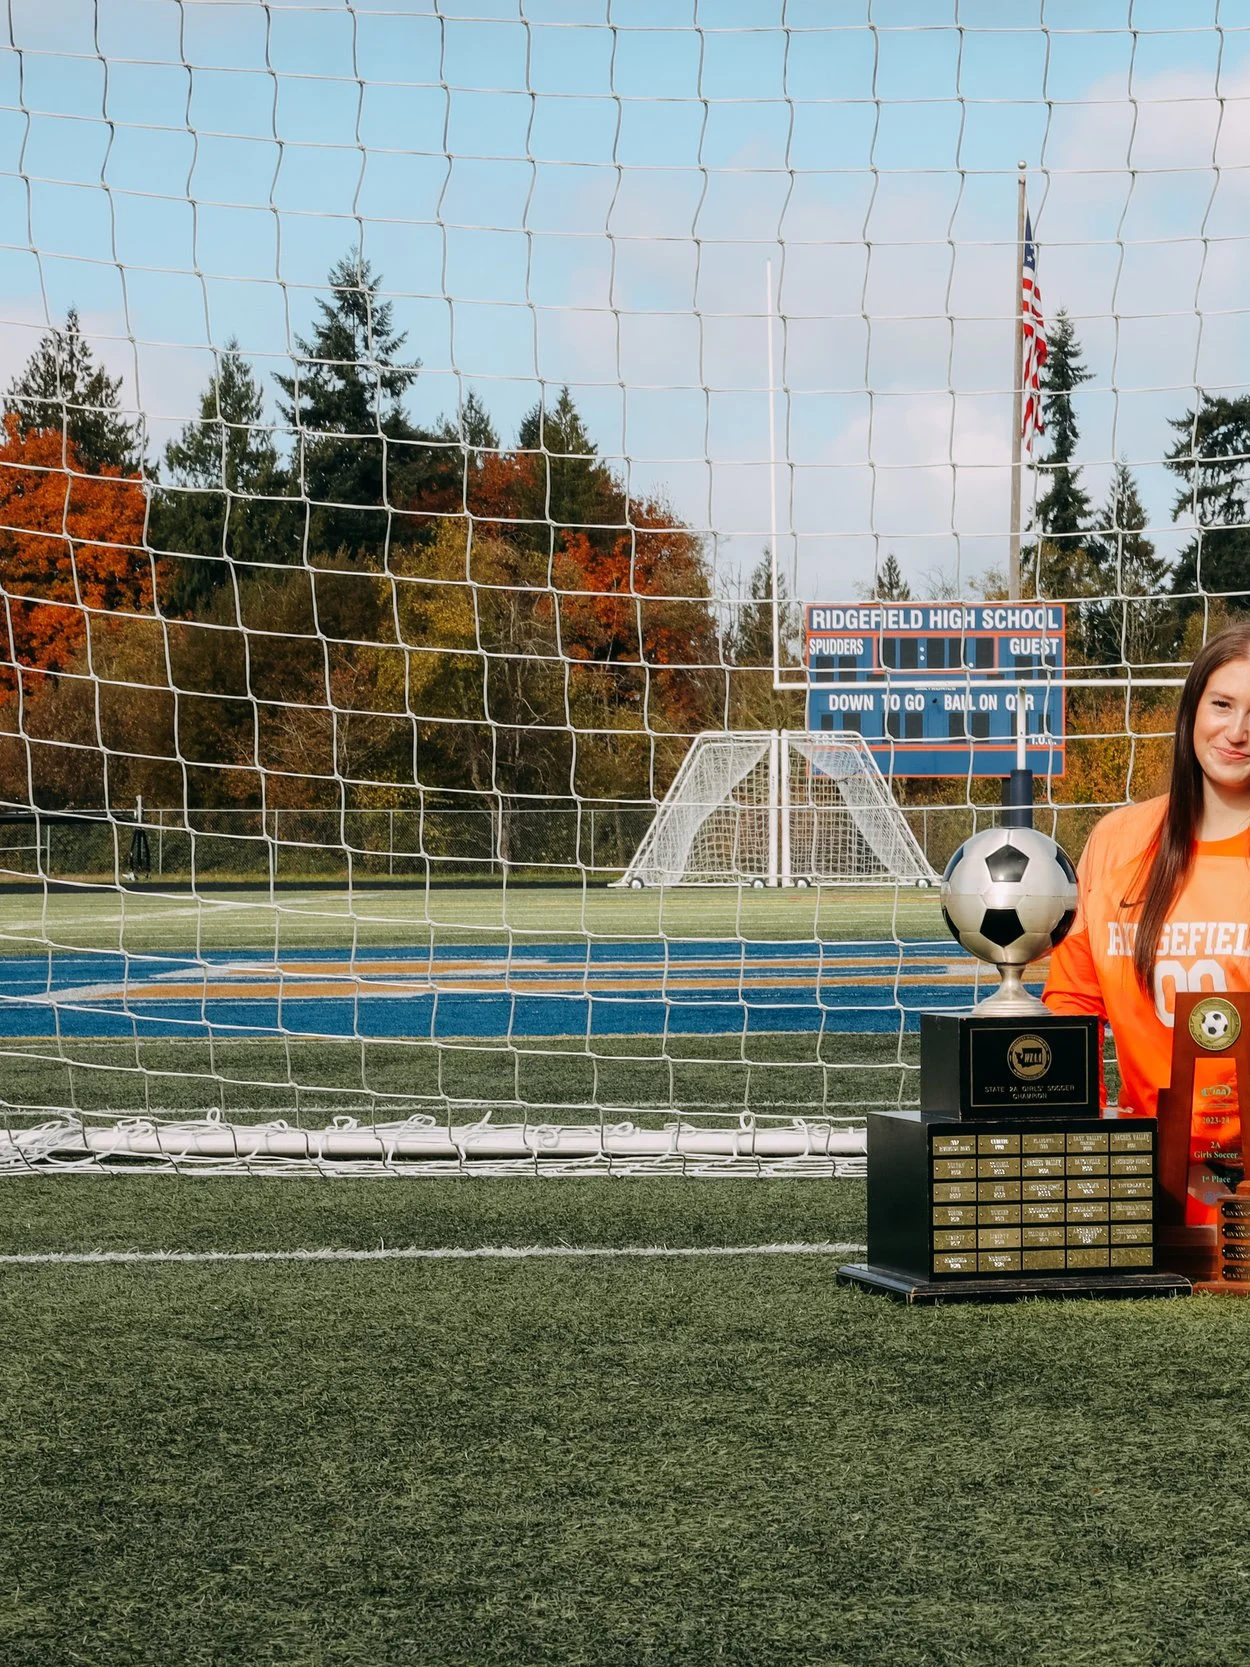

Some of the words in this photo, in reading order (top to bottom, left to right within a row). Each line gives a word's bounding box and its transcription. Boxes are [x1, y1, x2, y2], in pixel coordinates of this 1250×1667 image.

[812, 609, 923, 629] RIDGEFIELD
[929, 609, 976, 629] HIGH
[982, 609, 1059, 629] SCHOOL
[809, 638, 864, 655] SPUDDERS
[1009, 638, 1060, 655] GUEST
[828, 694, 874, 711] DOWN
[881, 694, 901, 711] TO
[904, 694, 925, 711] GO
[944, 694, 976, 711] BALL
[980, 694, 998, 711] ON
[1005, 694, 1035, 711] QR
[1210, 1141, 1221, 1149] 2A
[1194, 1151, 1212, 1159] Girls
[1213, 1151, 1238, 1159] Soccer
[1211, 1175, 1231, 1183] Place
